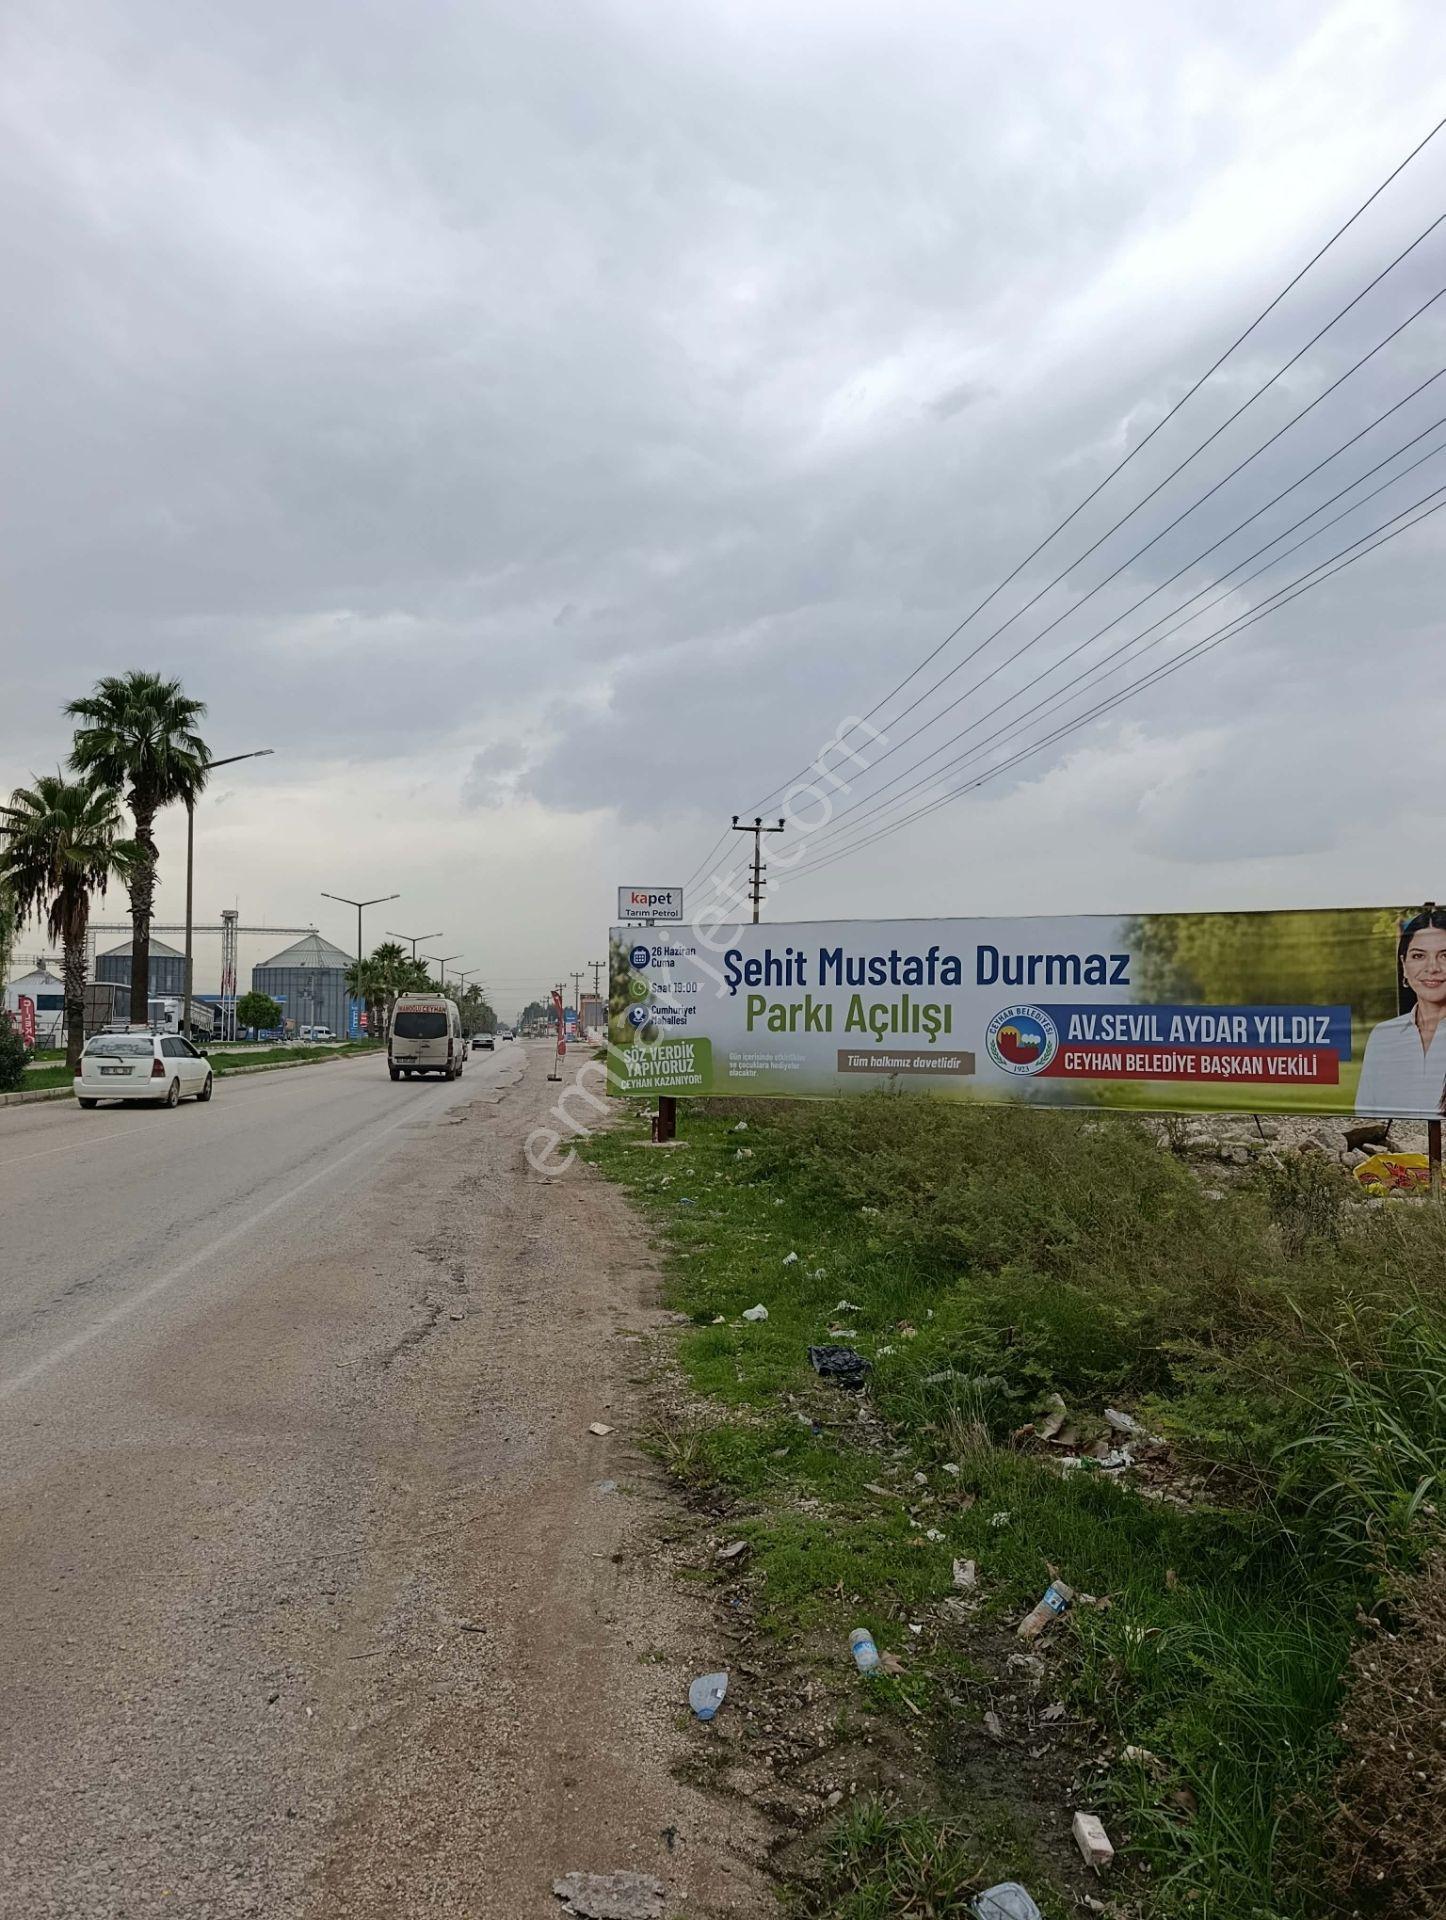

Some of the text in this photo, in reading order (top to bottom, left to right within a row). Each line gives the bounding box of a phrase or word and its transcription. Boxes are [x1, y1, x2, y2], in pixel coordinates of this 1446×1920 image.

[631, 891, 672, 906] kapet
[625, 909, 678, 917] Tarım Petrol
[651, 946, 696, 956] 26 Haziran
[651, 957, 675, 968] Cuma
[723, 945, 1130, 996] Şehit Mustafa Durmaz
[651, 982, 671, 993] Saat
[651, 1004, 696, 1017] Cumhuriyet
[746, 993, 952, 1043] Parkı Açılışı
[989, 1009, 1014, 1034] CEYHAN
[1067, 1014, 1331, 1044] AV.SEVIL AYDAR YILDIZ
[623, 1041, 695, 1064] SÖZ VERDİK
[625, 1058, 695, 1077] YAPIYORUZ
[847, 1055, 963, 1070] Tüm halkımız davetlidir
[1013, 1064, 1030, 1073] 1923
[1064, 1051, 1317, 1077] CEYHAN BELEDİYE BAŞKAN VEKİLİ
[654, 1075, 703, 1087] KAZANIYOR!
